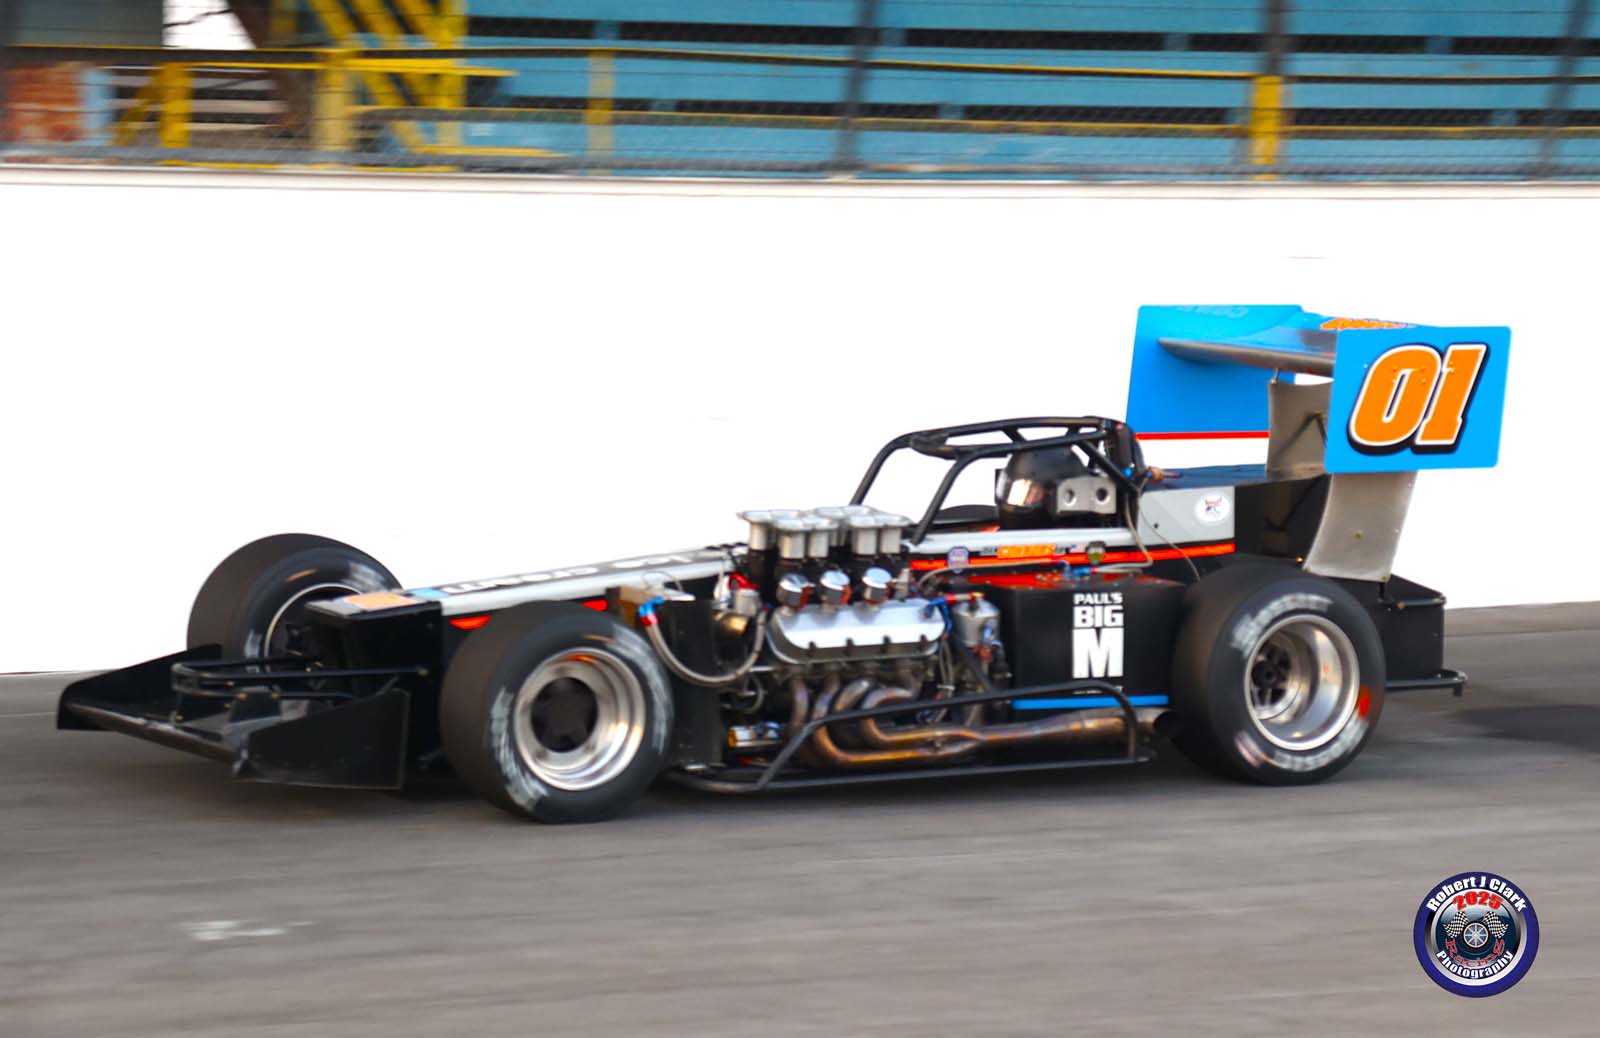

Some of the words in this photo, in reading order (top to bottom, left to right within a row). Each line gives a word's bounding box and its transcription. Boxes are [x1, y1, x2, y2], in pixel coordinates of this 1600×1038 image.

[1347, 343, 1490, 455] 01
[1073, 592, 1123, 605] PAUL'S
[1073, 605, 1124, 628] BIG
[1072, 628, 1124, 679] M
